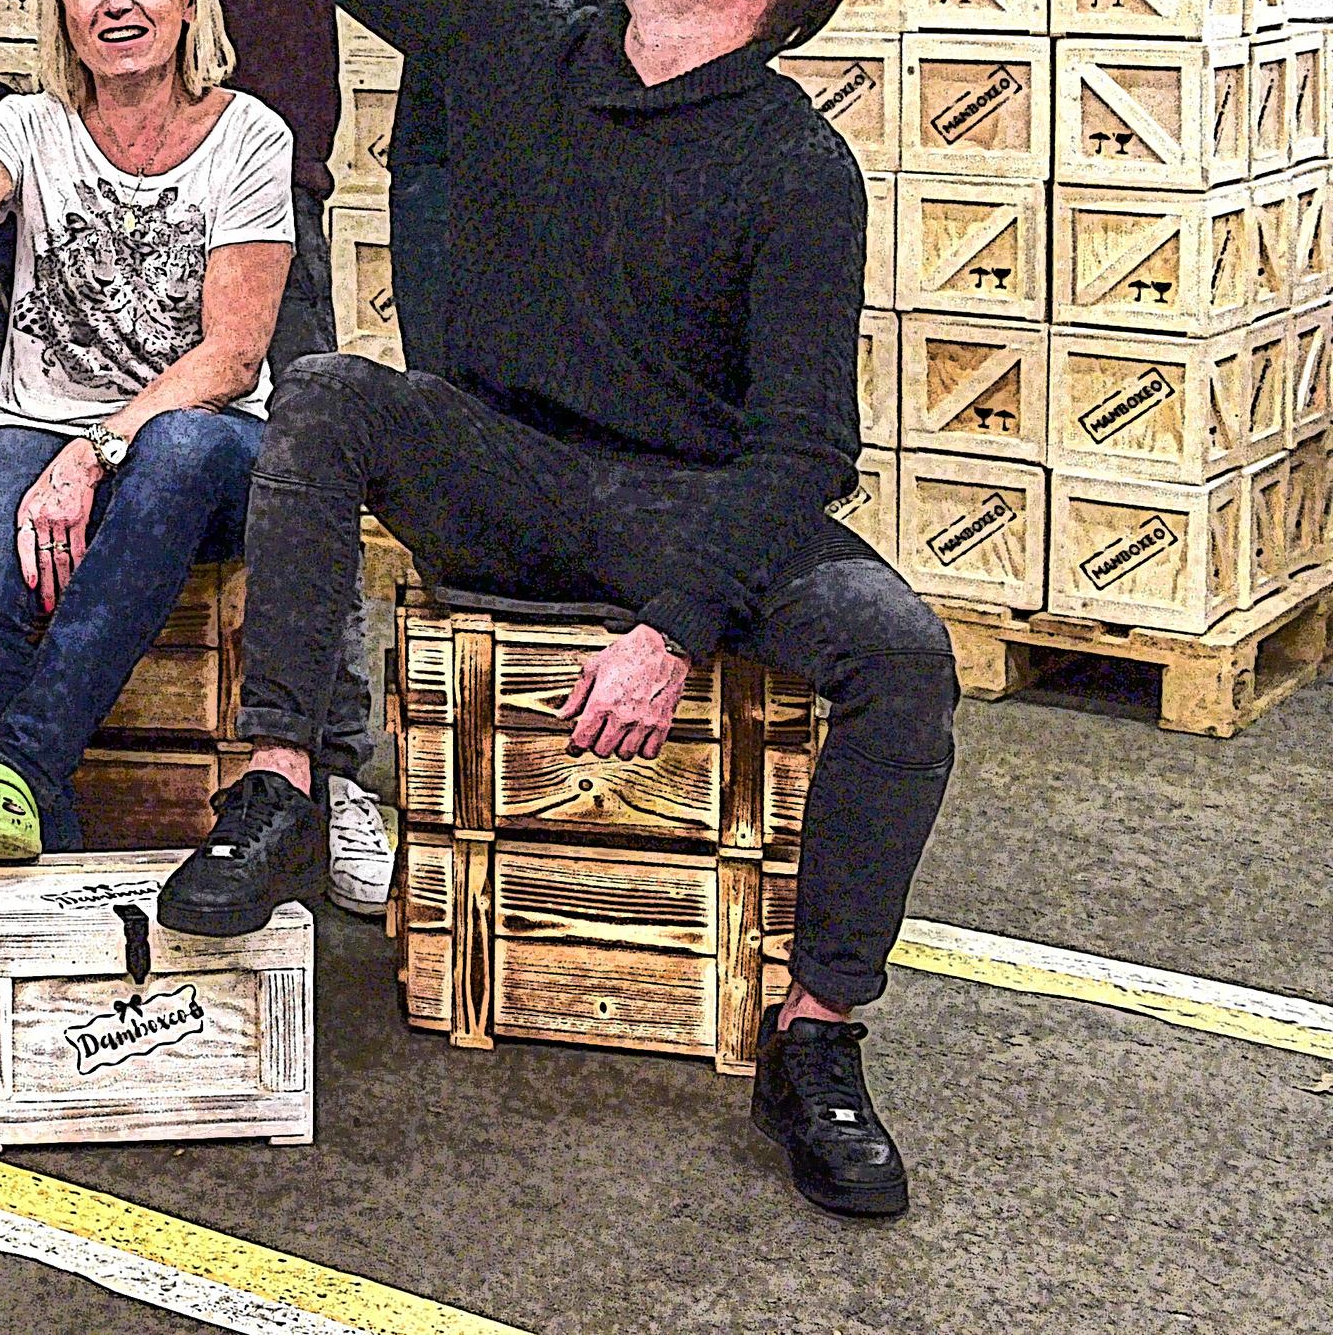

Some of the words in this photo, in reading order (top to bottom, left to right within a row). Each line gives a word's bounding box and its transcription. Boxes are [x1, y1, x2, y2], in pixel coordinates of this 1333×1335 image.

[940, 75, 1011, 138] MANBOXEO
[1089, 377, 1165, 437] MANBOXEO
[938, 502, 1007, 557] MANBOXEO
[1091, 525, 1167, 580] MANBOXEO
